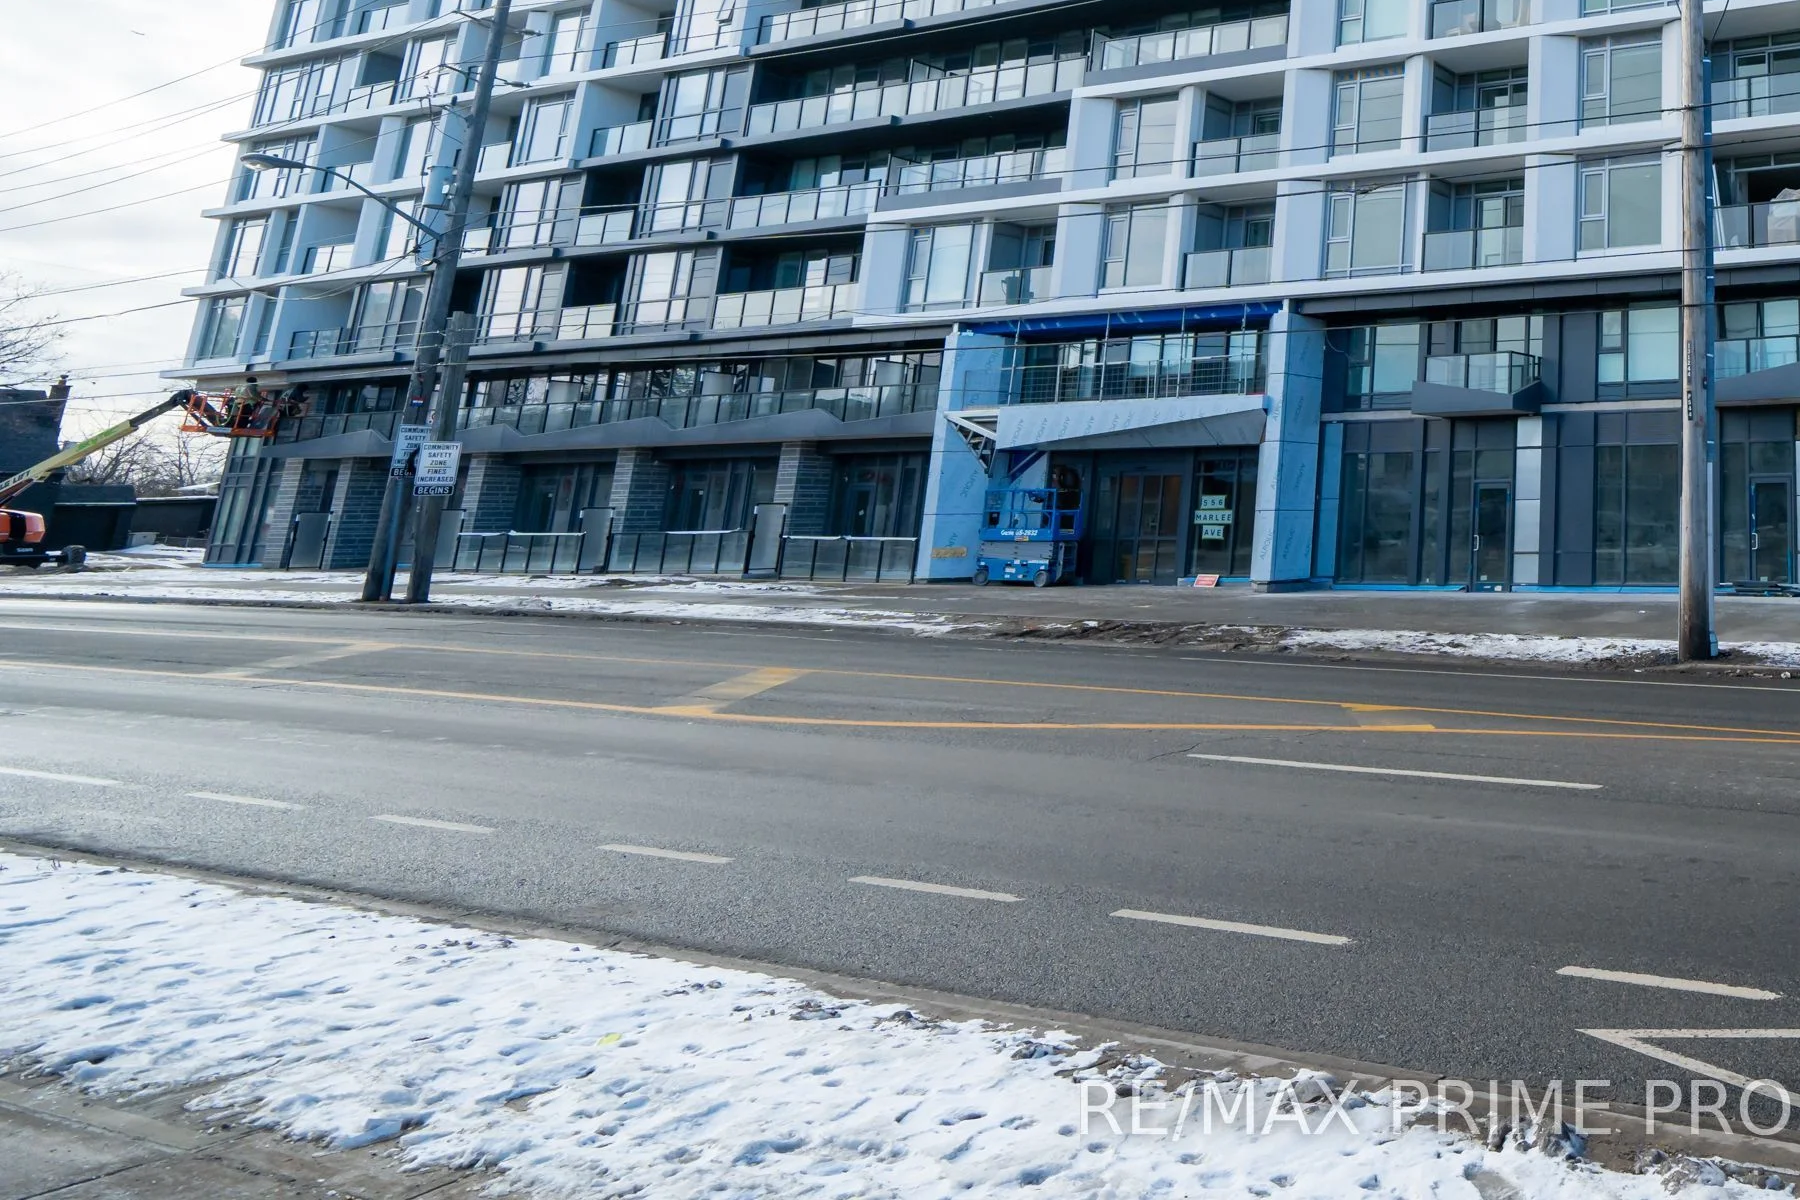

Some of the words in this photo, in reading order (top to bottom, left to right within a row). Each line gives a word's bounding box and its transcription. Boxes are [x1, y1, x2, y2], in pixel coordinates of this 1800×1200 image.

[418, 485, 450, 495] BEGINS
[1195, 513, 1232, 521] MARLEE
[1203, 528, 1222, 537] AVE
